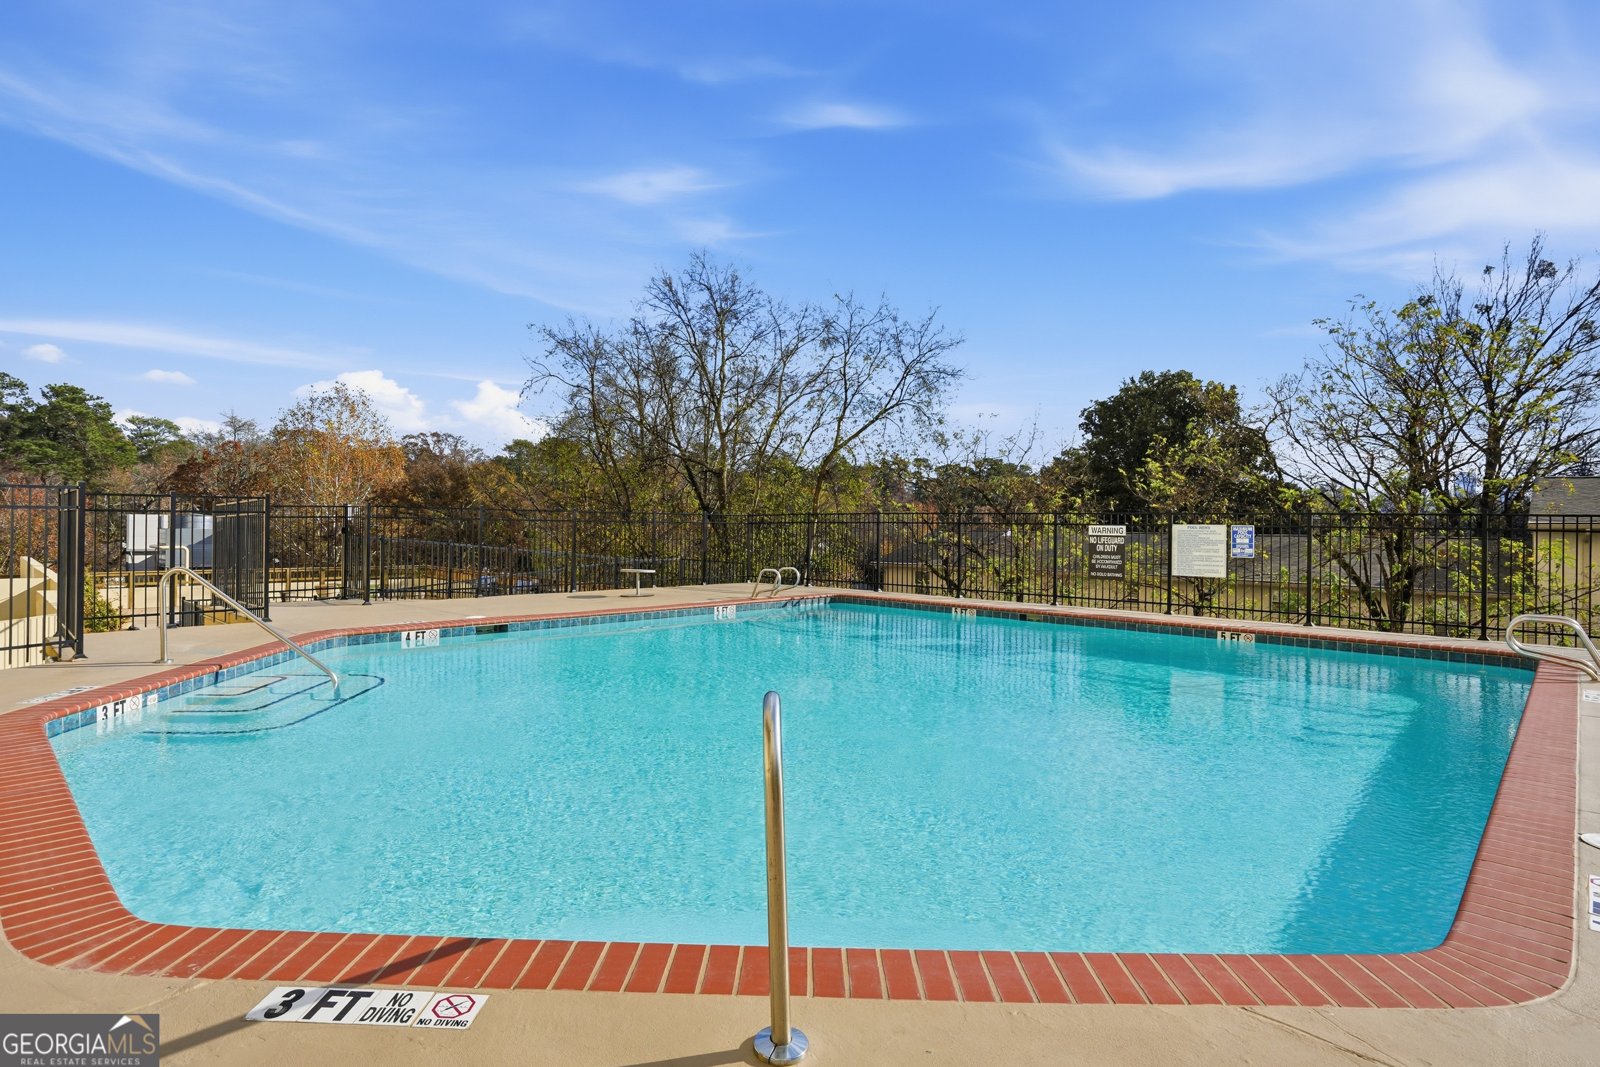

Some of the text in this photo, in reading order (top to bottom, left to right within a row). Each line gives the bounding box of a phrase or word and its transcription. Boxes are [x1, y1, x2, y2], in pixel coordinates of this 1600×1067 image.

[1091, 526, 1124, 534] WARNING
[405, 631, 426, 640] 4 FT
[1221, 632, 1241, 641] 5 FT
[102, 700, 126, 720] 3 FT
[264, 989, 374, 1021] 3 FT
[386, 992, 413, 1007] NO
[358, 1006, 416, 1023] DIVING
[434, 1019, 468, 1027] DIVING
